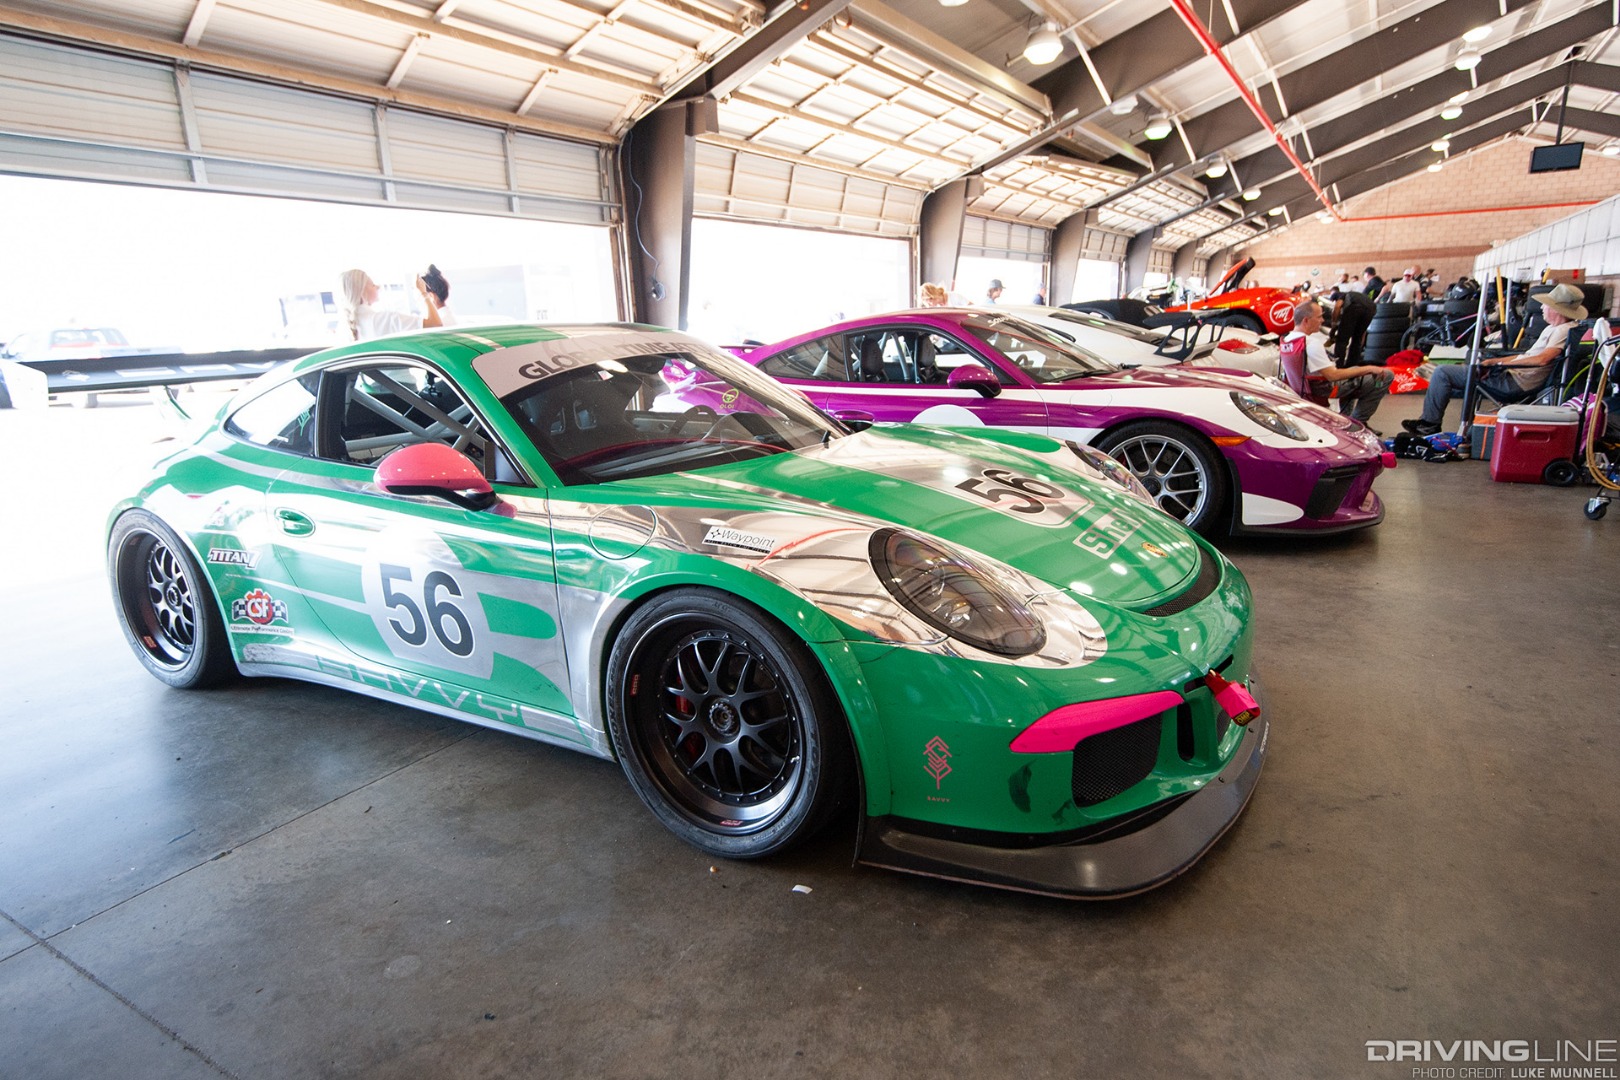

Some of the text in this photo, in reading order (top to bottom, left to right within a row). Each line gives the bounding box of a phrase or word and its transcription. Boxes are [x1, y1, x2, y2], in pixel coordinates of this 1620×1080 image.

[955, 469, 1065, 513] 56
[722, 529, 775, 548] Waypoint
[247, 598, 269, 617] CSF
[380, 563, 474, 657] 56
